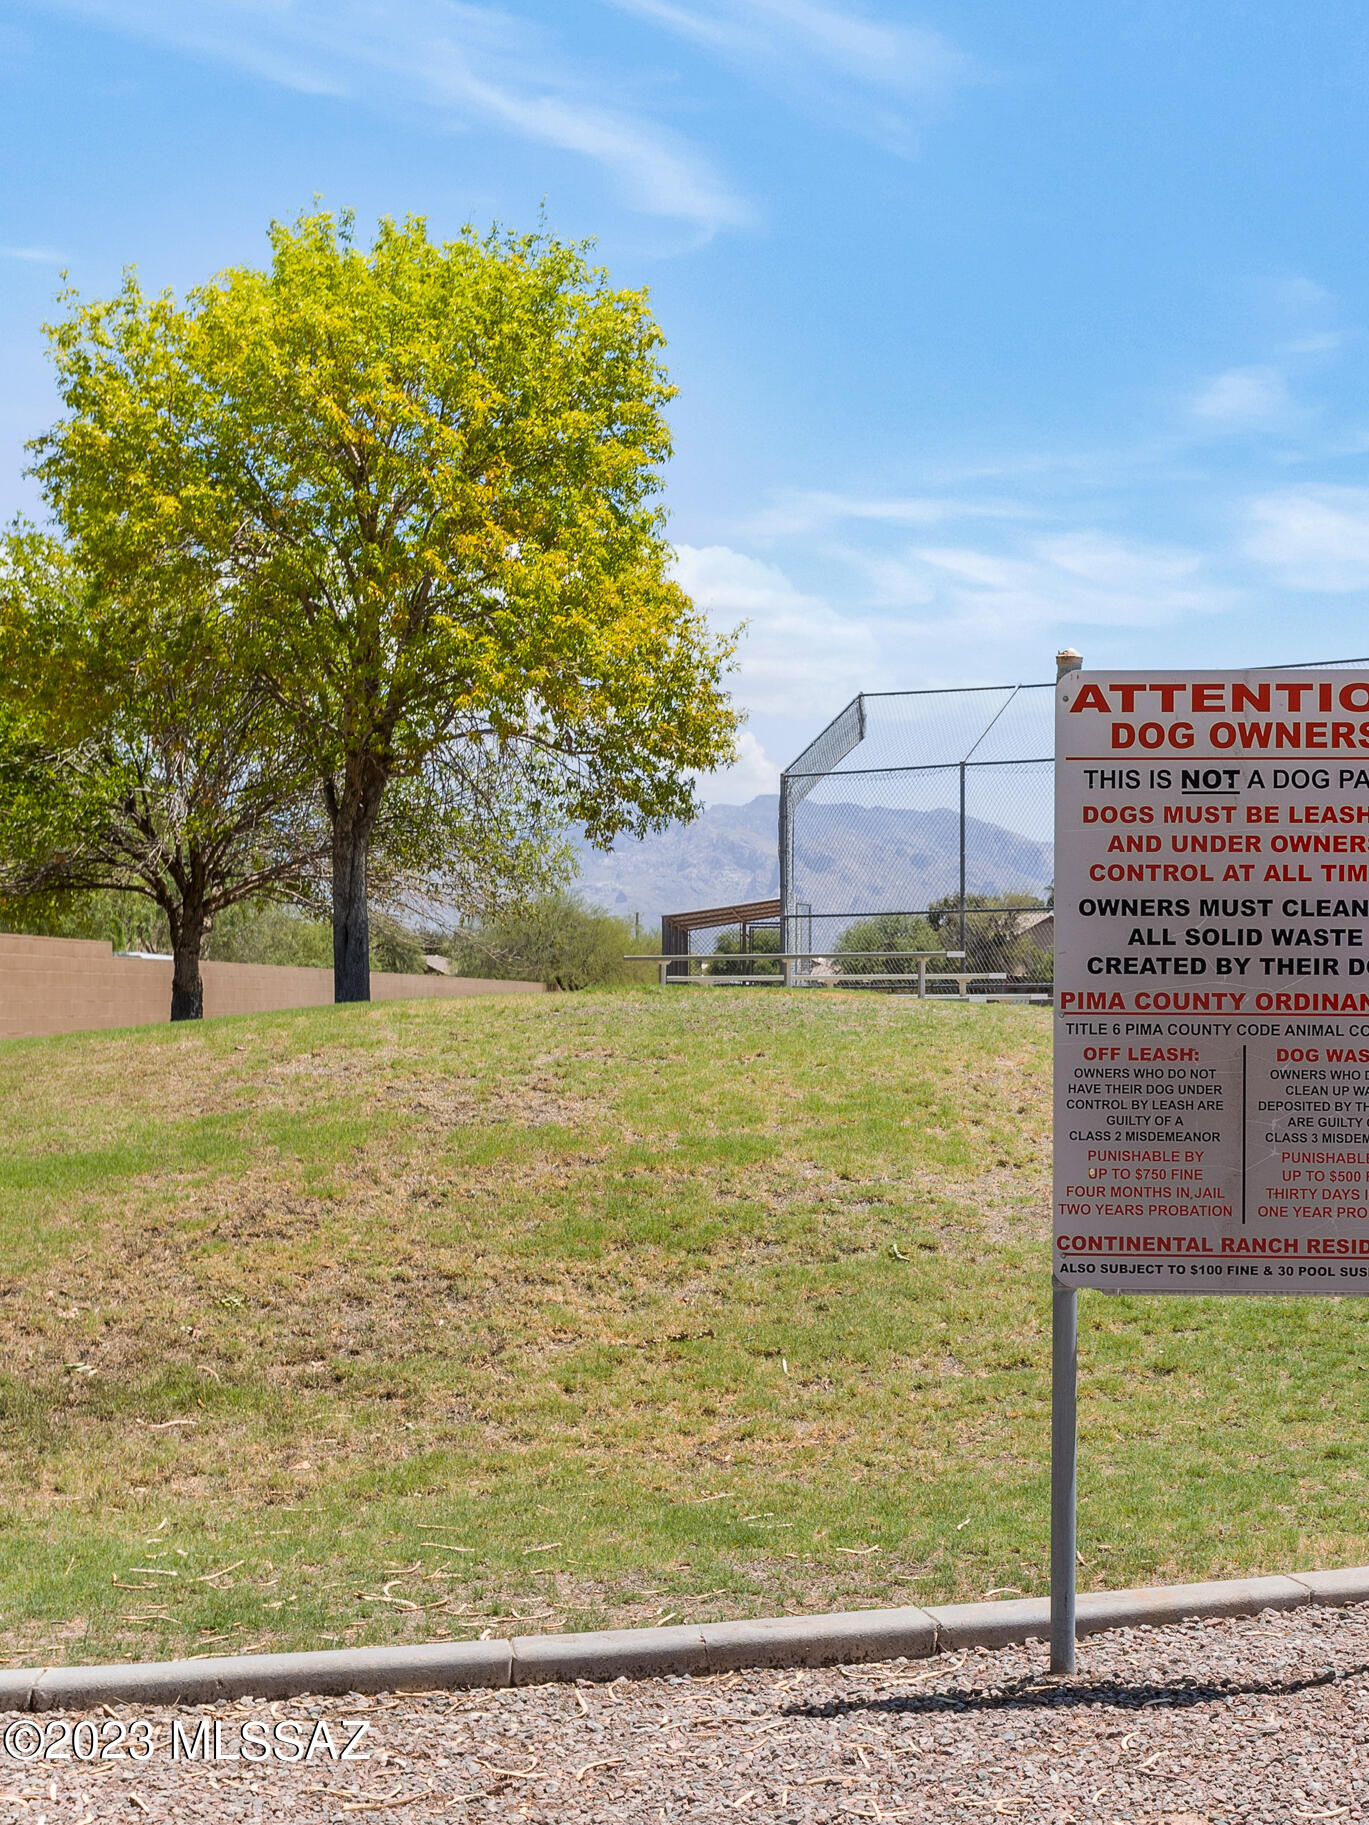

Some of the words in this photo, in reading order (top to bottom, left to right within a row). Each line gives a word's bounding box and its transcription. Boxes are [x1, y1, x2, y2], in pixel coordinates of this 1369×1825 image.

[1111, 721, 1195, 750] DOG
[1083, 769, 1141, 790] THIS
[1149, 769, 1172, 789] IS
[1181, 769, 1241, 790] NOT
[1246, 769, 1266, 789] A
[1273, 769, 1330, 790] DOG
[1082, 805, 1155, 824] DOGS
[1163, 805, 1238, 824] MUST
[1246, 805, 1280, 824] BE
[1107, 835, 1162, 853] AND
[1171, 835, 1262, 853] UNDER
[1089, 863, 1214, 882] CONTROL
[1222, 864, 1256, 882] AT
[1263, 864, 1313, 882] ALL
[1078, 898, 1191, 917] OWNERS
[1199, 899, 1274, 917] MUST
[1282, 899, 1369, 918] CLEAN
[1127, 928, 1177, 946] ALL
[1184, 928, 1263, 946] SOLID
[1270, 928, 1363, 947] WASTE
[1087, 956, 1207, 975] CREATED
[1216, 957, 1252, 975] BY
[1259, 957, 1340, 976] THEIR
[1060, 991, 1126, 1010] PIMA
[1134, 991, 1247, 1011] COUNTY
[1065, 1022, 1108, 1035] TITLE
[1112, 1023, 1121, 1036] 6
[1125, 1023, 1164, 1036] PIMA
[1167, 1023, 1233, 1036] COUNTY
[1236, 1023, 1281, 1036] CODE
[1284, 1024, 1345, 1037] ANIMAL
[1083, 1047, 1121, 1061] OFF
[1128, 1047, 1200, 1062] LEASH:
[1276, 1048, 1319, 1063] DOG
[1074, 1067, 1130, 1079] OWNERS
[1133, 1068, 1164, 1079] WHO
[1167, 1068, 1187, 1079] DO
[1190, 1068, 1217, 1080] NOT
[1269, 1069, 1327, 1080] OWNERS
[1329, 1069, 1361, 1081] WHO
[1068, 1083, 1102, 1094] HAVE
[1104, 1083, 1143, 1095] THEIR
[1146, 1084, 1174, 1095] DOG
[1178, 1084, 1223, 1095] UNDER
[1285, 1085, 1329, 1096] CLEAN
[1332, 1085, 1350, 1096] UP
[1066, 1099, 1129, 1110] CONTROL
[1131, 1099, 1149, 1110] BY
[1152, 1099, 1194, 1111] LEASH
[1197, 1100, 1224, 1111] ARE
[1258, 1100, 1331, 1112] DEPOSITED
[1334, 1101, 1352, 1112] BY
[1106, 1115, 1152, 1126] GUILTY
[1154, 1115, 1172, 1126] OF
[1174, 1115, 1184, 1127] A
[1287, 1116, 1314, 1128] ARE
[1317, 1117, 1364, 1128] GUILTY
[1069, 1130, 1111, 1142] CLASS
[1114, 1131, 1122, 1142] 2
[1125, 1131, 1221, 1143] MISDEMEANOR
[1265, 1132, 1308, 1143] CLASS
[1311, 1132, 1319, 1144] 3
[1088, 1150, 1180, 1162] PUNISHABLE
[1184, 1150, 1205, 1163] BY
[1088, 1167, 1108, 1180] UP
[1111, 1168, 1131, 1180] TO
[1135, 1167, 1167, 1181] $750
[1171, 1168, 1203, 1181] FINE
[1282, 1170, 1302, 1182] UP
[1305, 1170, 1325, 1182] TO
[1329, 1170, 1361, 1183] $500
[1066, 1185, 1106, 1198] FOUR
[1110, 1185, 1172, 1199] MONTHS
[1176, 1186, 1190, 1199] IN
[1194, 1187, 1225, 1199] JAIL
[1265, 1187, 1318, 1200] THIRTY
[1322, 1188, 1360, 1201] DAYS
[1058, 1203, 1091, 1216] TWO
[1095, 1203, 1144, 1216] YEARS
[1148, 1204, 1233, 1217] PROBATION
[1257, 1205, 1289, 1218] ONE
[1292, 1206, 1333, 1218] YEAR
[1056, 1235, 1214, 1253] CONTINENTAL
[1221, 1237, 1299, 1254] RANCH
[1059, 1263, 1096, 1274] ALSO
[1100, 1263, 1164, 1275] SUBJECT
[1167, 1264, 1186, 1275] TO
[1190, 1264, 1223, 1276] $100
[1227, 1265, 1259, 1276] FINE
[1263, 1265, 1273, 1276] &
[1278, 1265, 1294, 1277] 30
[1298, 1266, 1336, 1277] POOL
